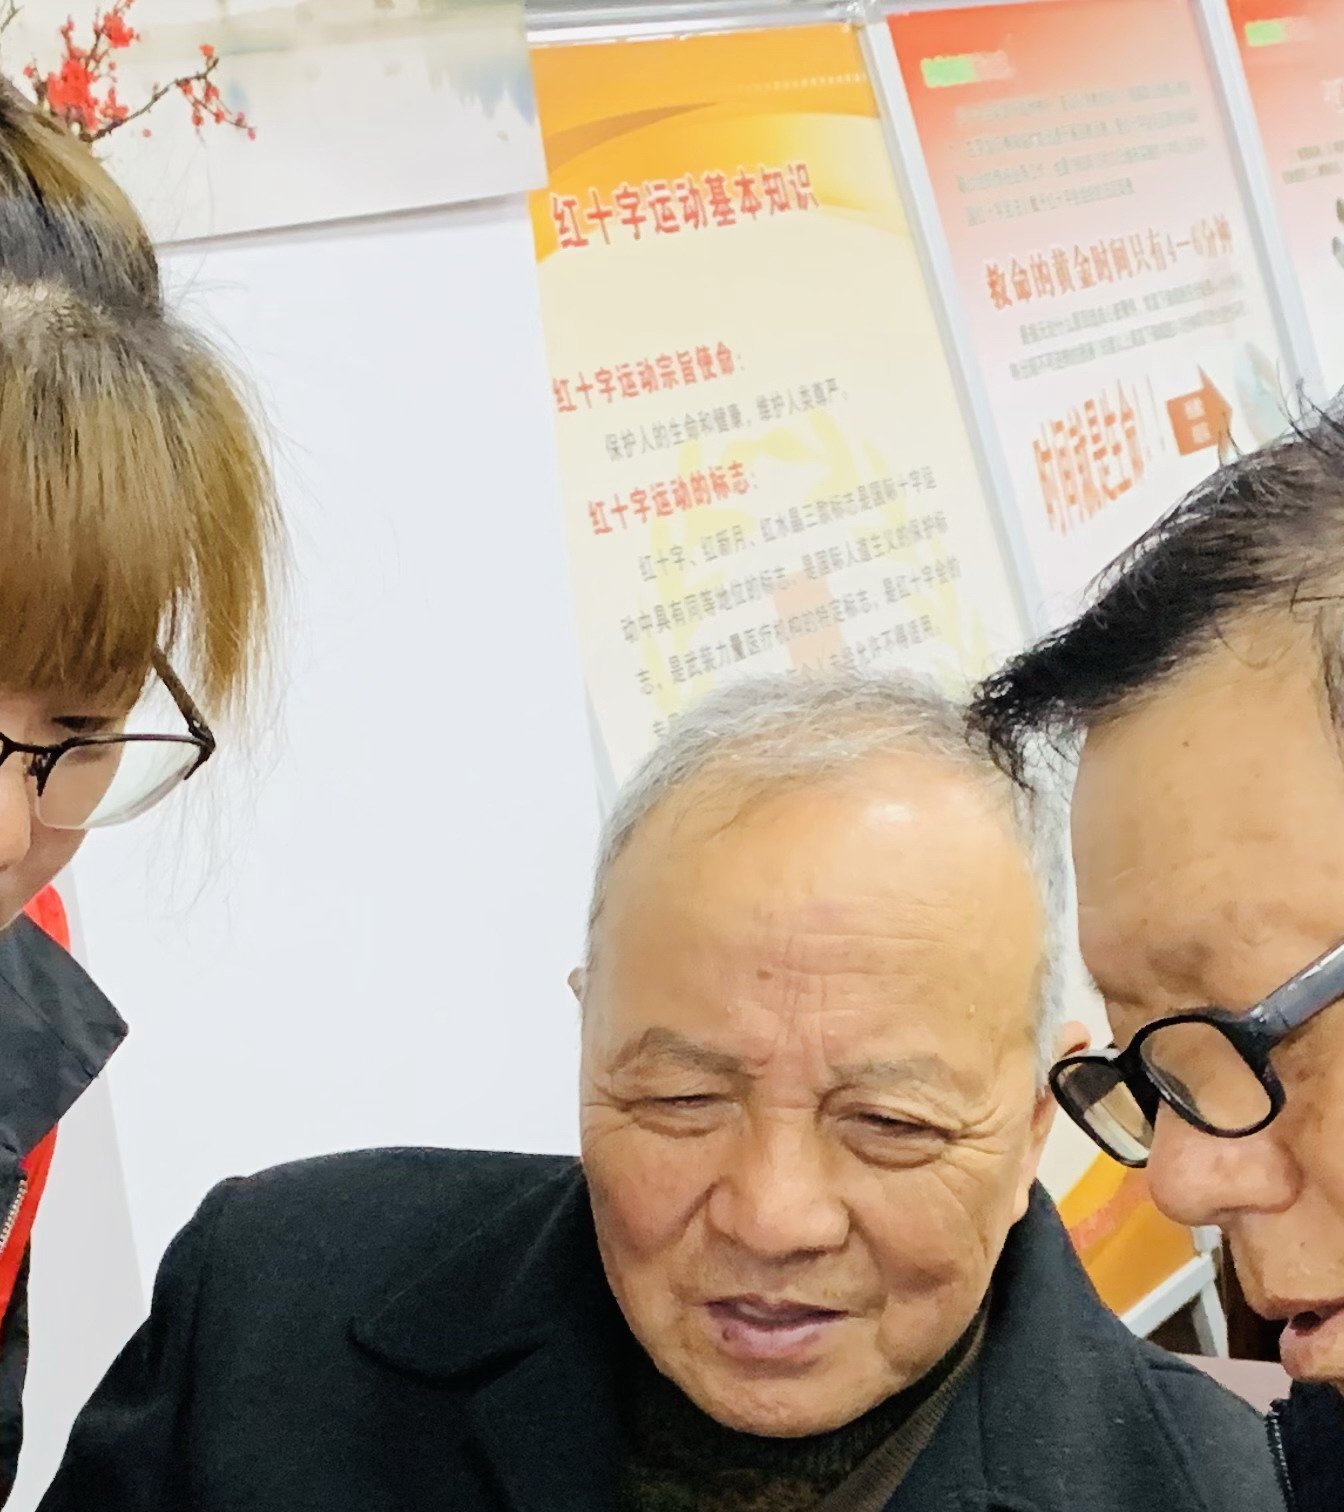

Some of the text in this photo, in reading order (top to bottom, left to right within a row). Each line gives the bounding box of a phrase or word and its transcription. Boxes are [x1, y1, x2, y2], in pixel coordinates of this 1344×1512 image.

[551, 163, 819, 249] 红十字运动基本知识
